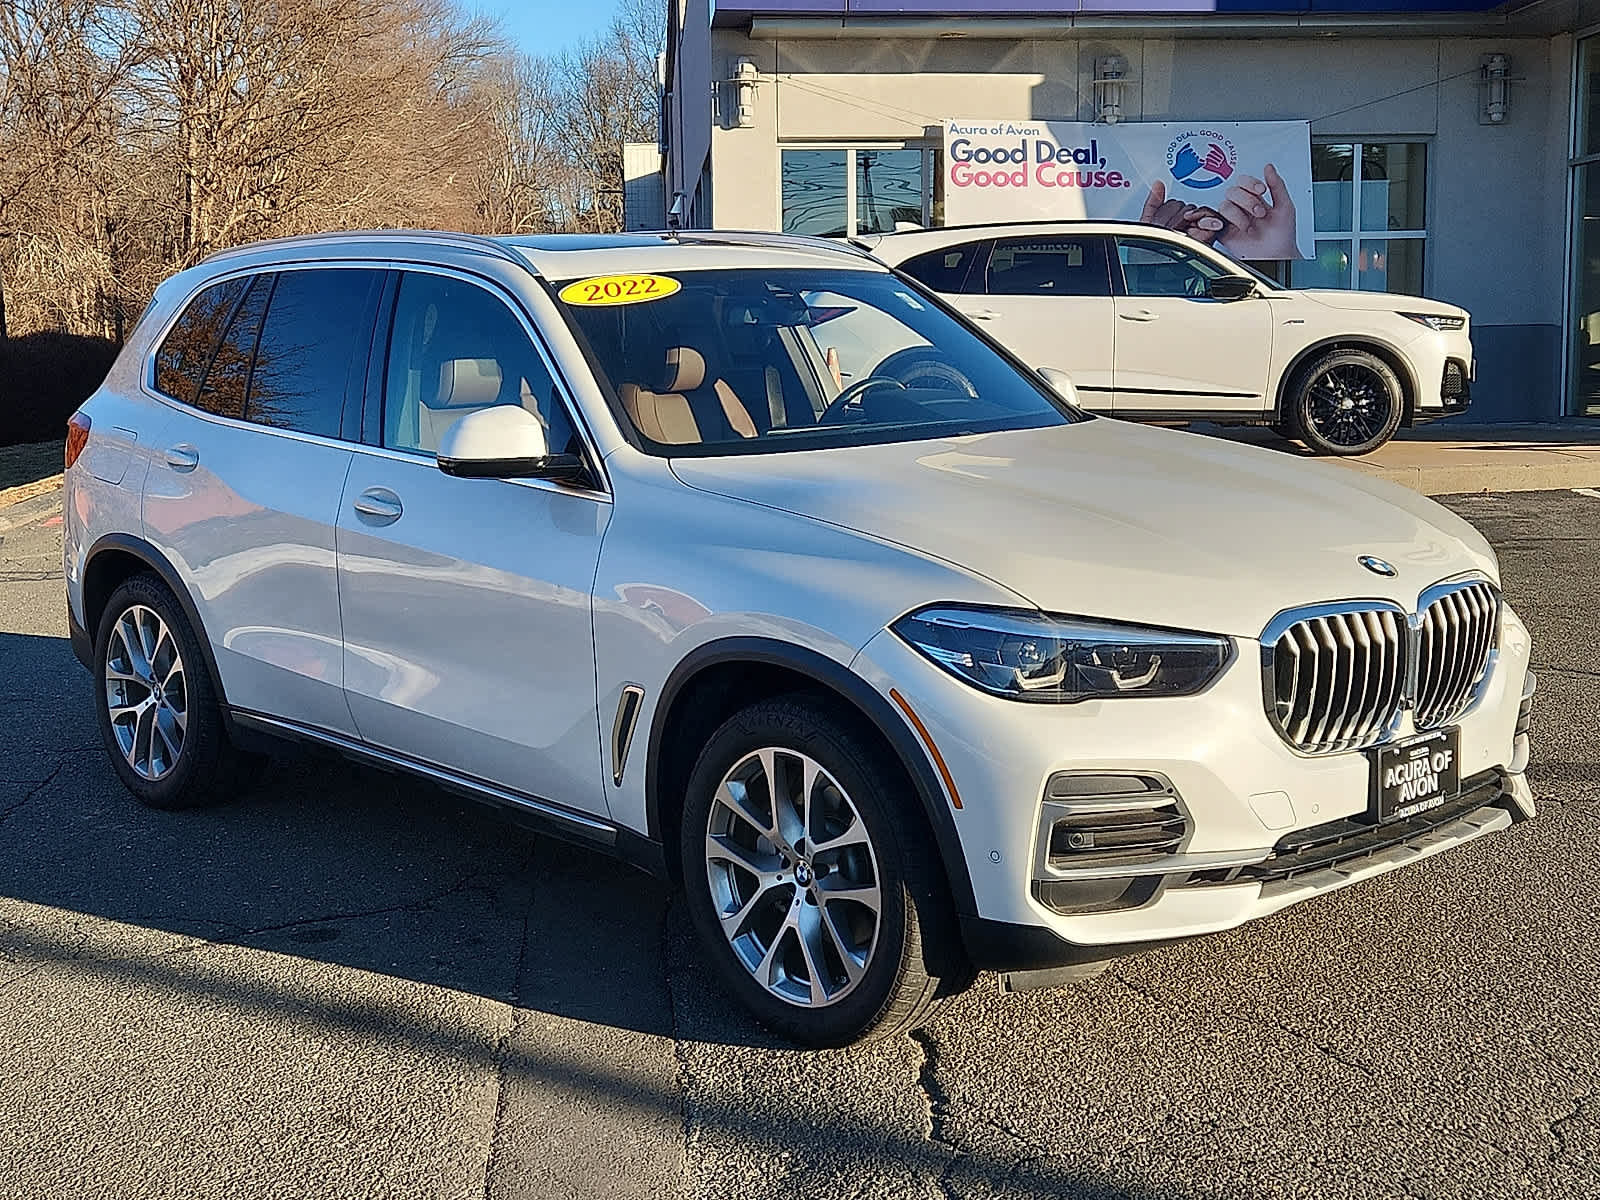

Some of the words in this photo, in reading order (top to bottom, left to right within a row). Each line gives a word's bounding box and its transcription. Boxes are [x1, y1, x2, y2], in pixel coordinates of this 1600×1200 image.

[949, 123, 988, 135] Acura
[990, 123, 1004, 135] of
[1006, 124, 1040, 136] Avon
[1200, 129, 1224, 141] GOOD
[950, 138, 1028, 164] Good
[1036, 139, 1107, 170] Deal,
[950, 161, 1029, 188] Good
[1035, 161, 1131, 188] Cause.
[583, 278, 661, 302] 2022
[1384, 757, 1431, 789] ACURA
[1432, 749, 1453, 773] OF
[1399, 772, 1439, 803] AVON
